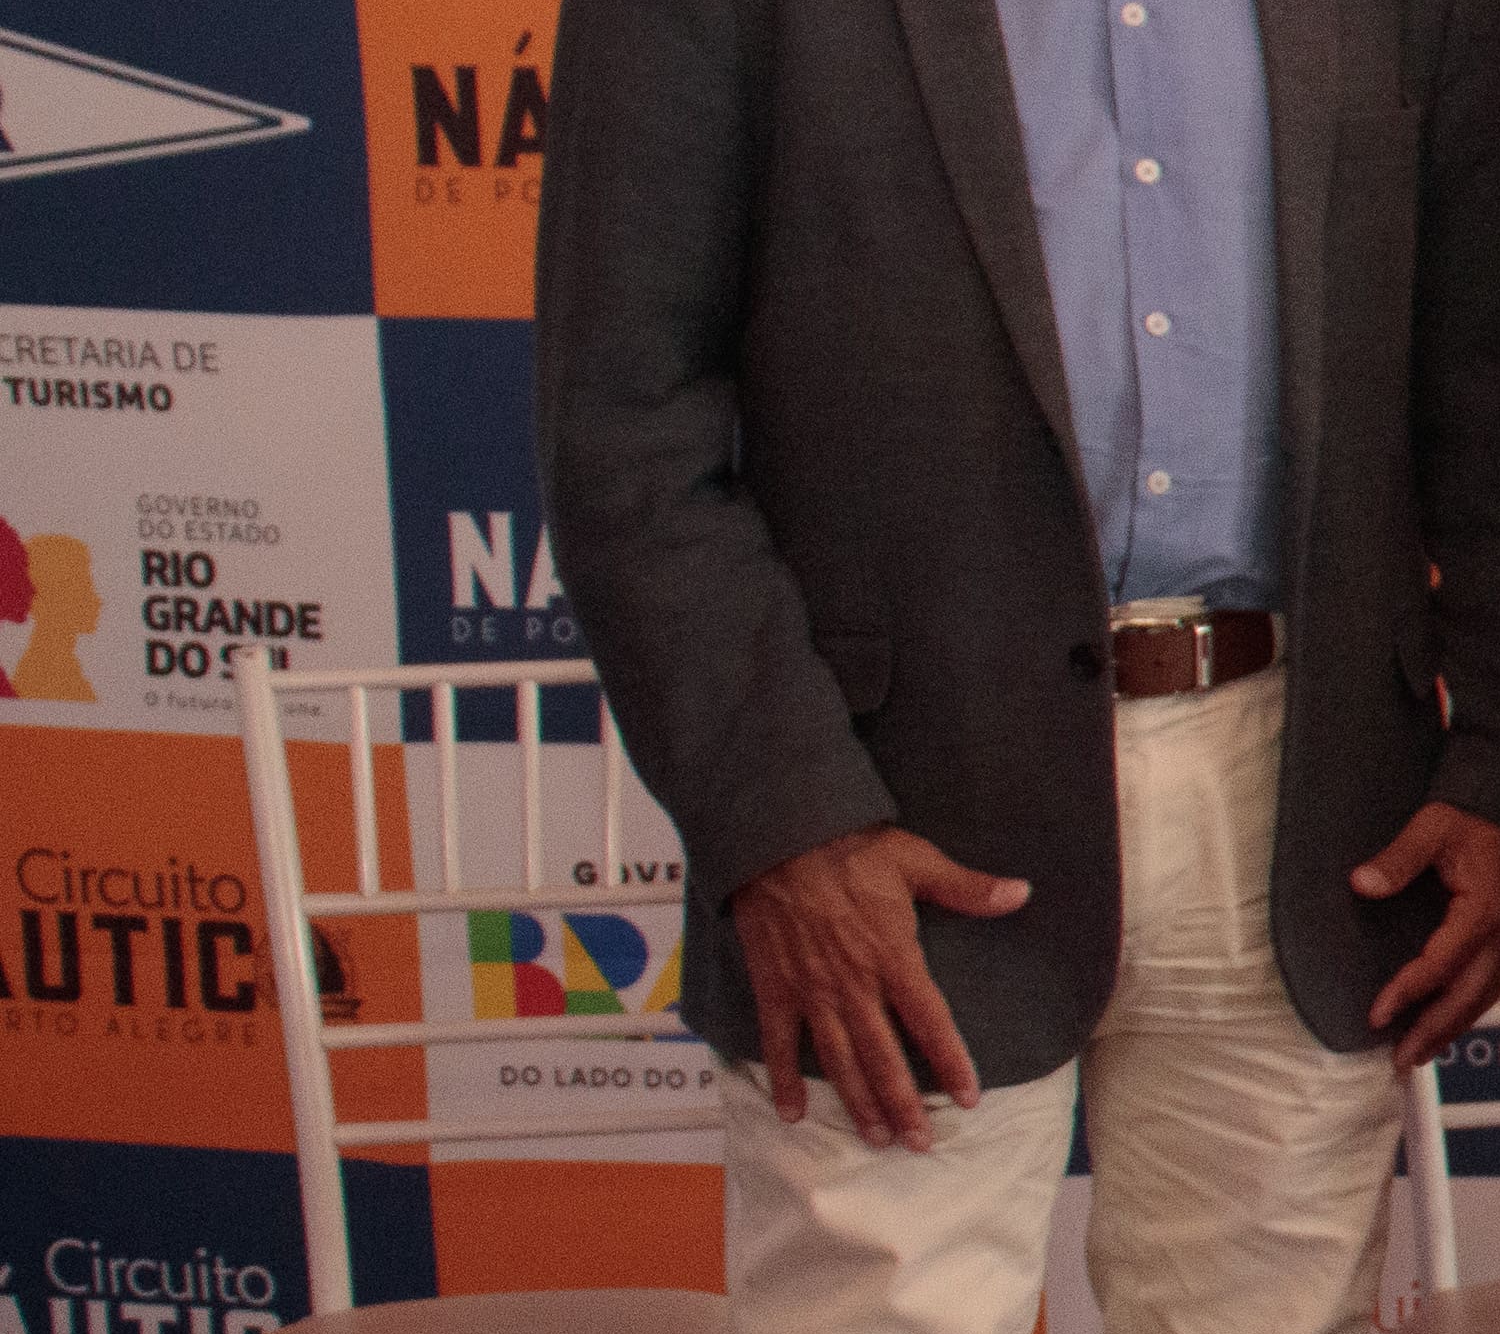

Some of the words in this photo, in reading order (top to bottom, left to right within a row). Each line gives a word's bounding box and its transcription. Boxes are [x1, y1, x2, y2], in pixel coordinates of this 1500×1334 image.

[416, 176, 461, 205] DE
[172, 341, 219, 373] DE
[5, 376, 174, 413] TURISMO
[136, 493, 260, 520] GOVERNO
[137, 519, 175, 540] DO
[185, 520, 281, 546] ESTADO
[141, 548, 216, 589] RIO
[142, 595, 323, 640] GRANDE
[146, 638, 211, 679] DO
[16, 847, 246, 914] Circuito
[1466, 1040, 1492, 1065] O
[500, 1065, 542, 1086] DO
[553, 1067, 632, 1087] LADO
[643, 1069, 686, 1089] DO
[46, 1238, 275, 1305] Circuito
